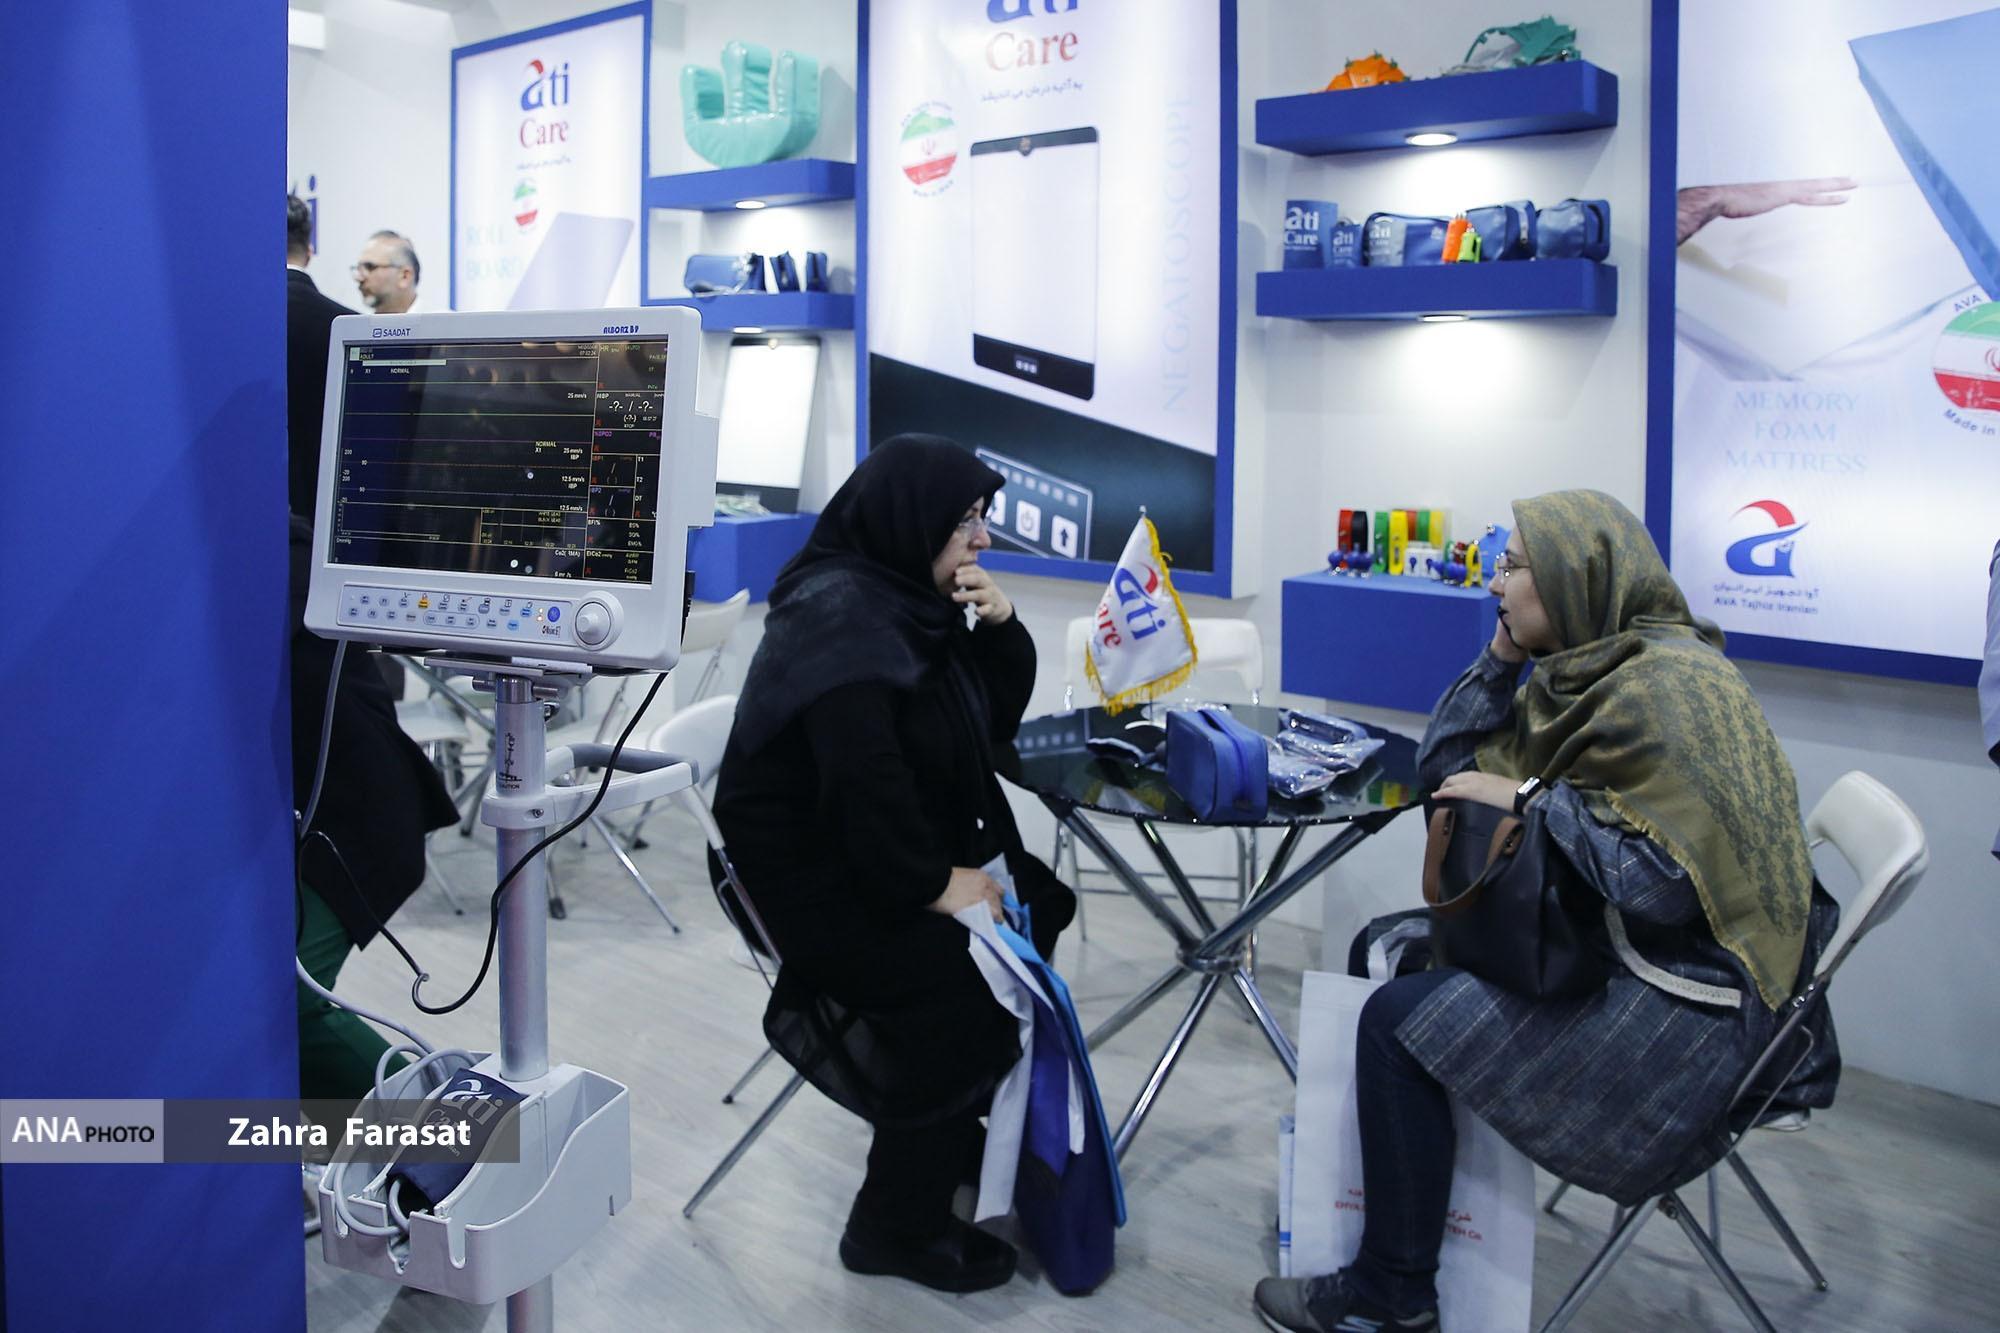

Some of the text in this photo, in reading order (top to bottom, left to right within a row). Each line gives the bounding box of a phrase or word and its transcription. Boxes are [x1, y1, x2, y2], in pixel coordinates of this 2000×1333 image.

[985, 32, 1078, 71] Care
[520, 59, 569, 111] ati
[520, 118, 569, 148] Care
[1284, 231, 1318, 246] Care
[1953, 294, 1982, 312] AVA
[383, 328, 411, 337] SAADAT
[603, 326, 629, 334] ALBORZ
[1734, 391, 1860, 411] MEMORY
[1754, 421, 1837, 442] FOAM
[1944, 409, 1996, 435] Made in
[1726, 450, 1867, 472] MATTRESS
[1114, 562, 1166, 640] ati
[1097, 603, 1121, 648] are
[441, 1079, 503, 1125] ati
